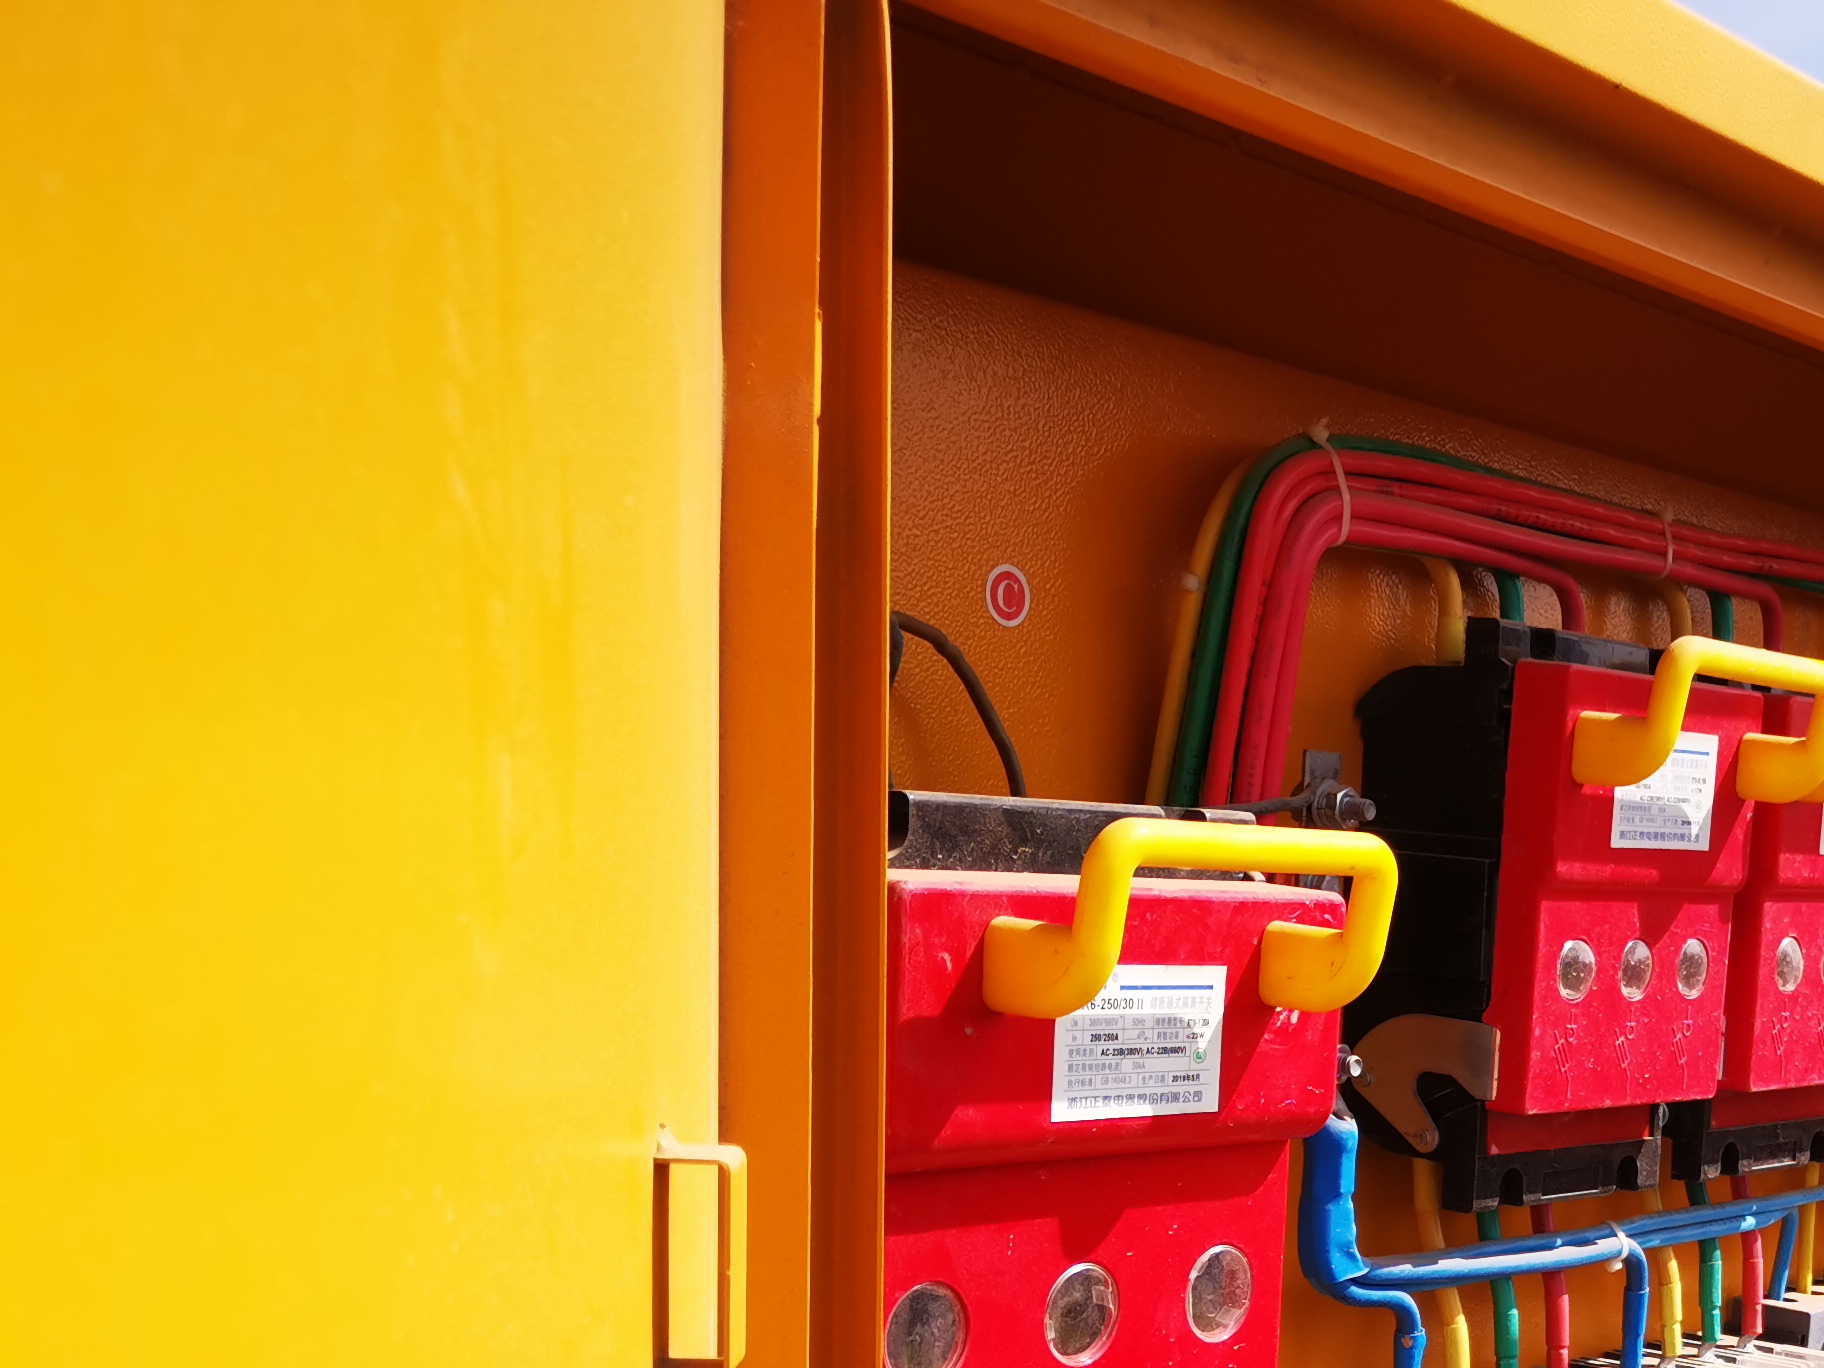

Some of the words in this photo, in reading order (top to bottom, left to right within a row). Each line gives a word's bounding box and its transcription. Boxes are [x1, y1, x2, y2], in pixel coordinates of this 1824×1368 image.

[997, 579, 1019, 613] C
[1066, 1090, 1204, 1111] 浙江正泰电器股份有限公司
